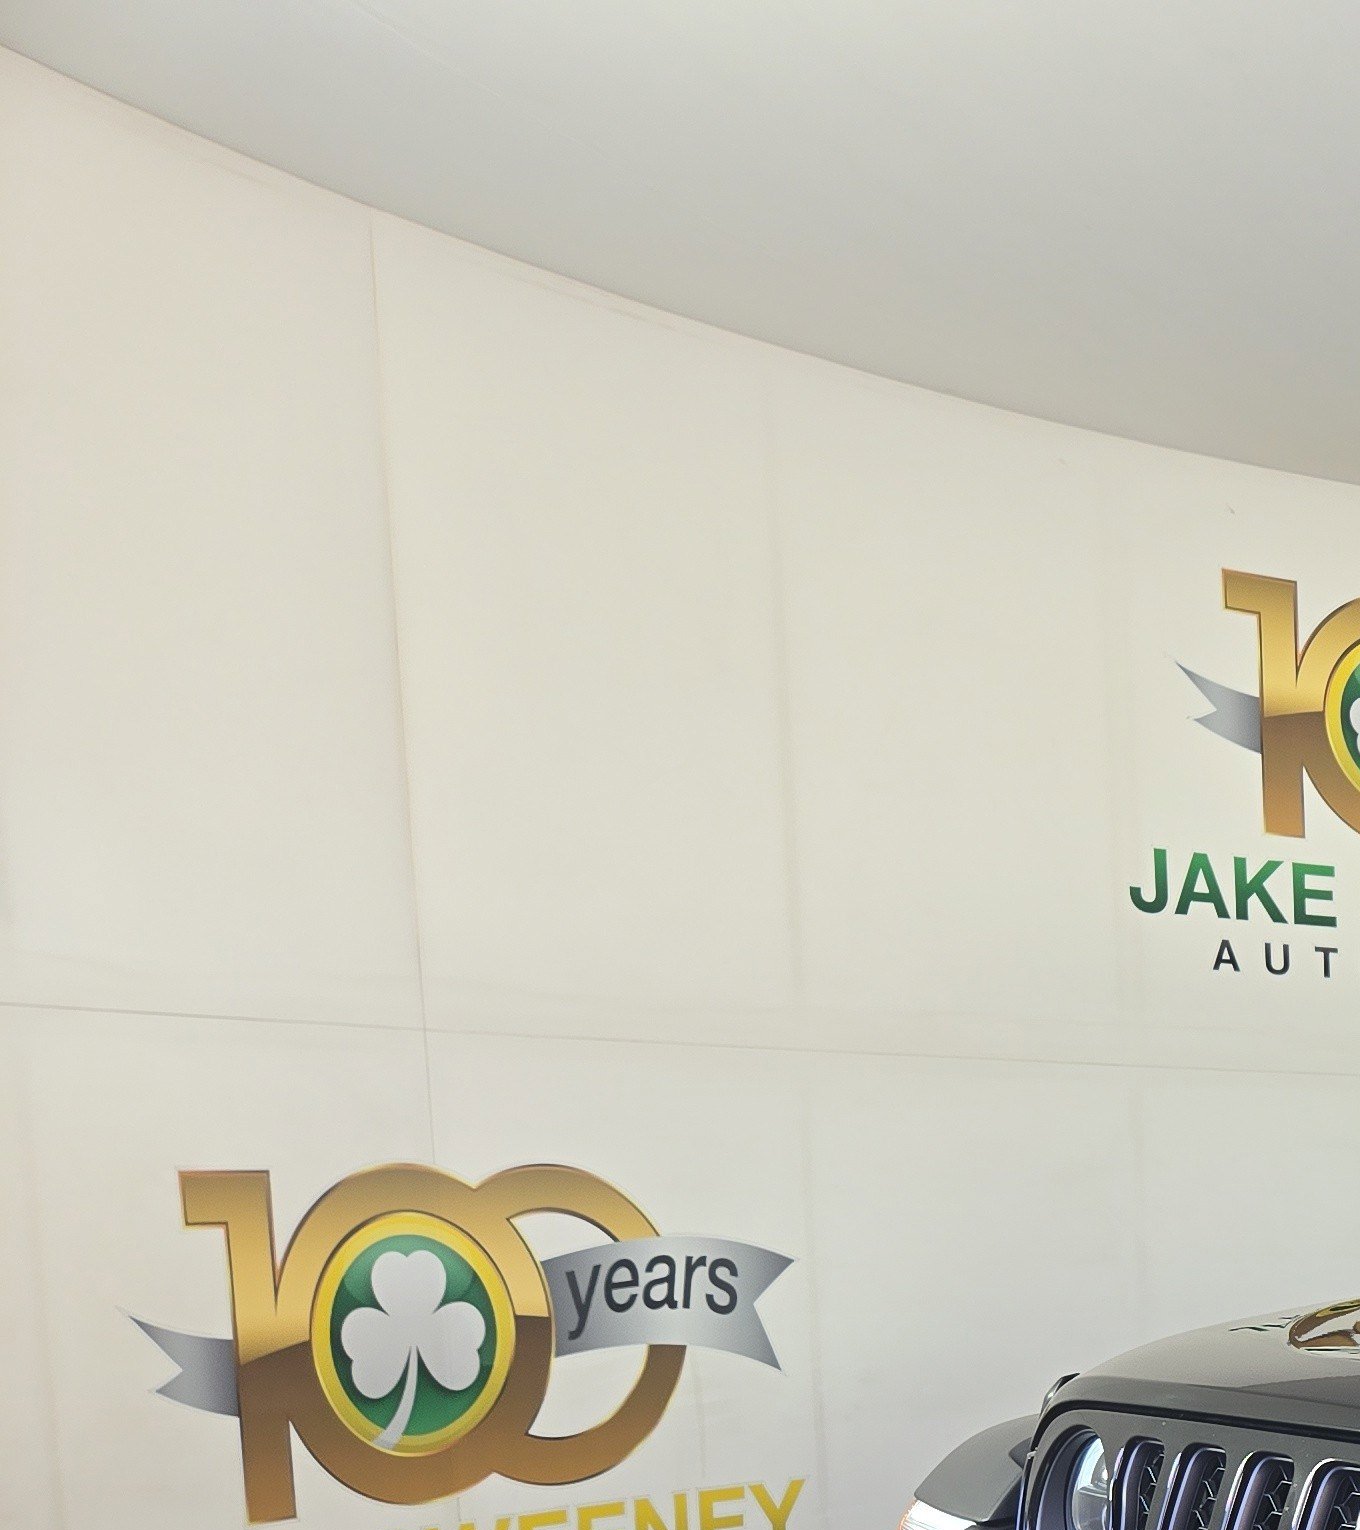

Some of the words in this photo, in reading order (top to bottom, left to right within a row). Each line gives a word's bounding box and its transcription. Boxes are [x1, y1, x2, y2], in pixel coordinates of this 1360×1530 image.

[1129, 848, 1338, 928] JAKE
[565, 1253, 740, 1339] years
[177, 1162, 688, 1525] 100
